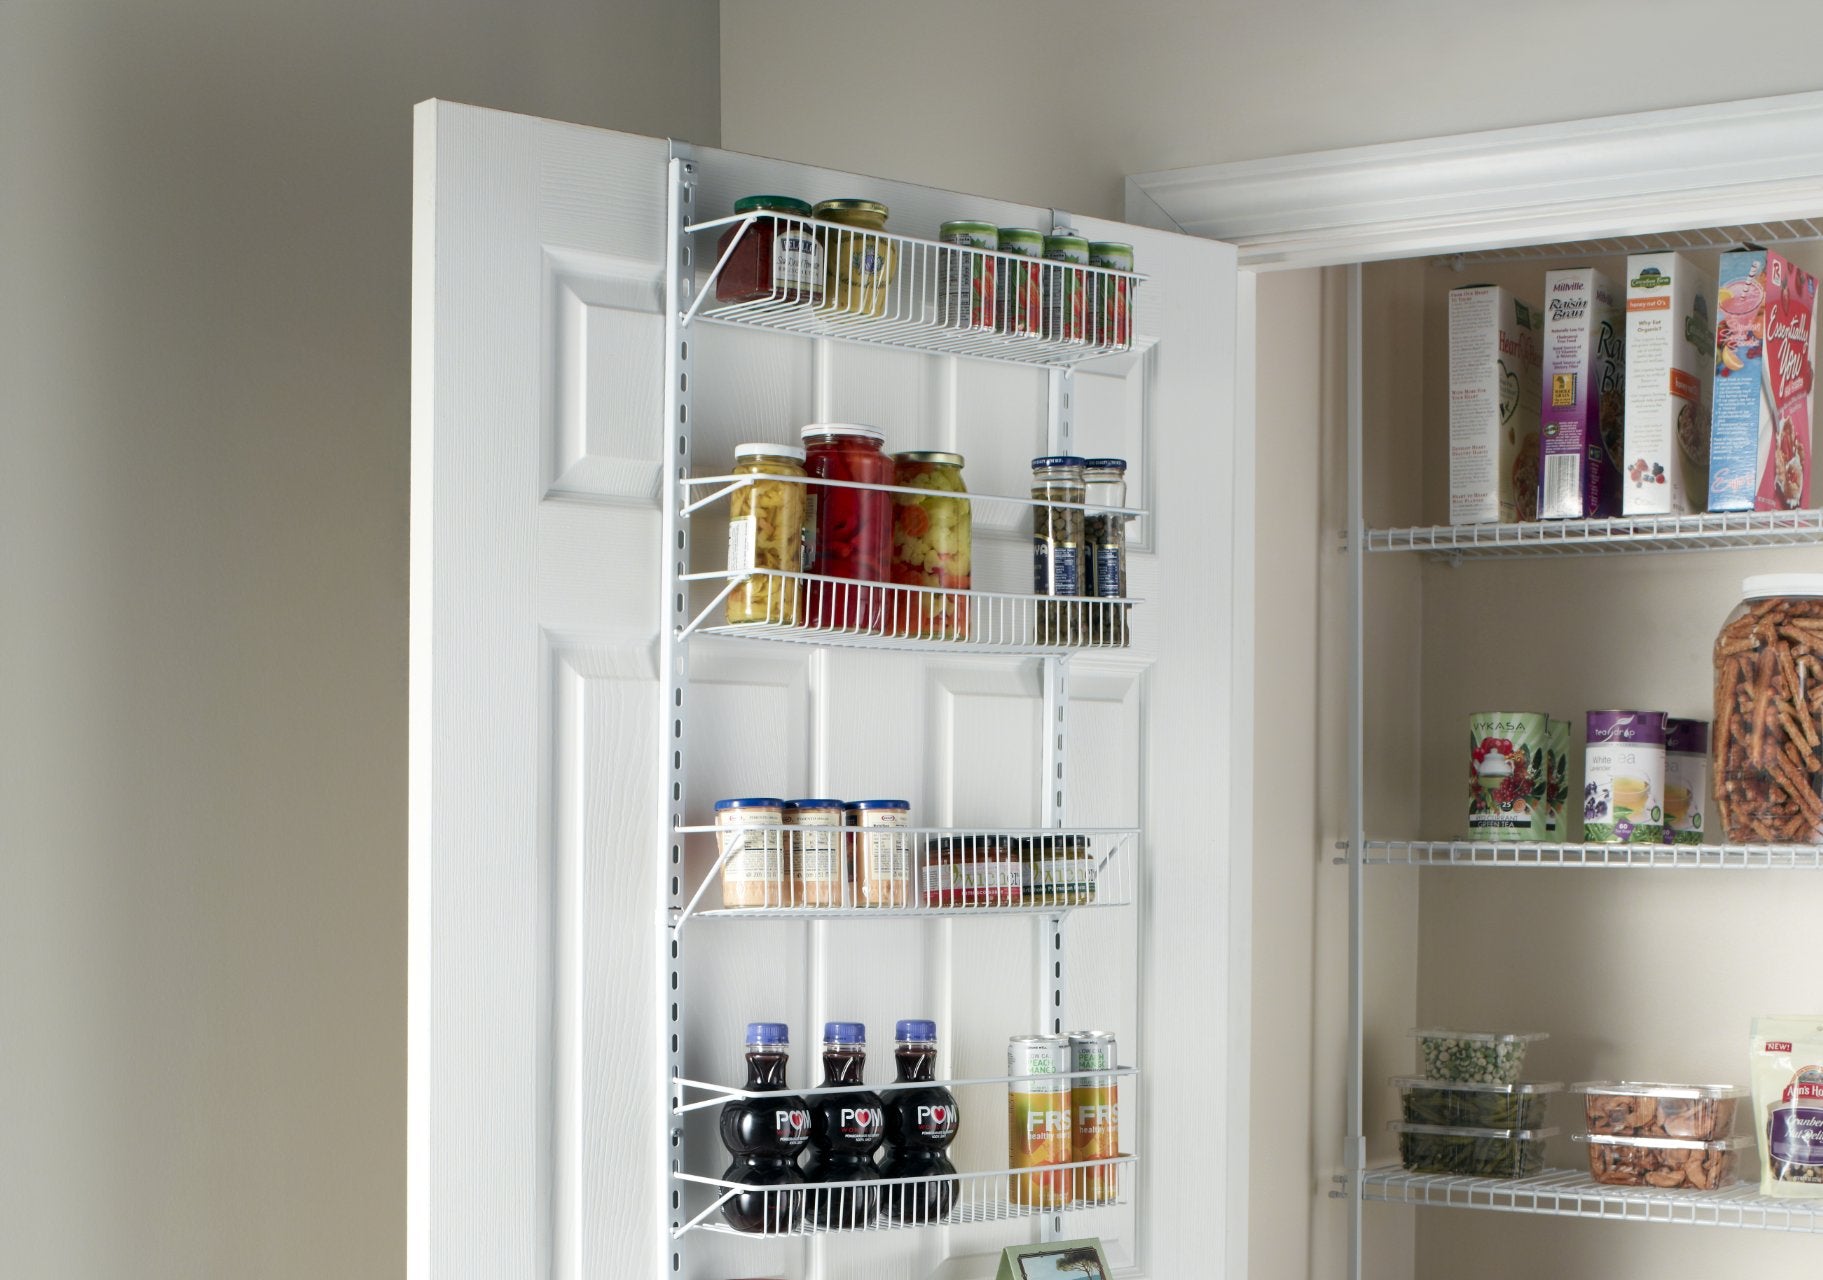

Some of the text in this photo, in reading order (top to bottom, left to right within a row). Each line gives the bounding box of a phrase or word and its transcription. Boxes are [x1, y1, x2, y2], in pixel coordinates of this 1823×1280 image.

[1553, 281, 1585, 293] Millville
[1549, 298, 1589, 312] Raisin
[1630, 300, 1647, 308] honey
[1551, 308, 1585, 321] Bran
[1767, 304, 1809, 352] Essentially
[1779, 343, 1801, 396] You
[1473, 722, 1526, 732] VYKASA
[1593, 756, 1611, 766] White
[1502, 801, 1511, 809] 25
[1767, 1042, 1790, 1050] NEW!
